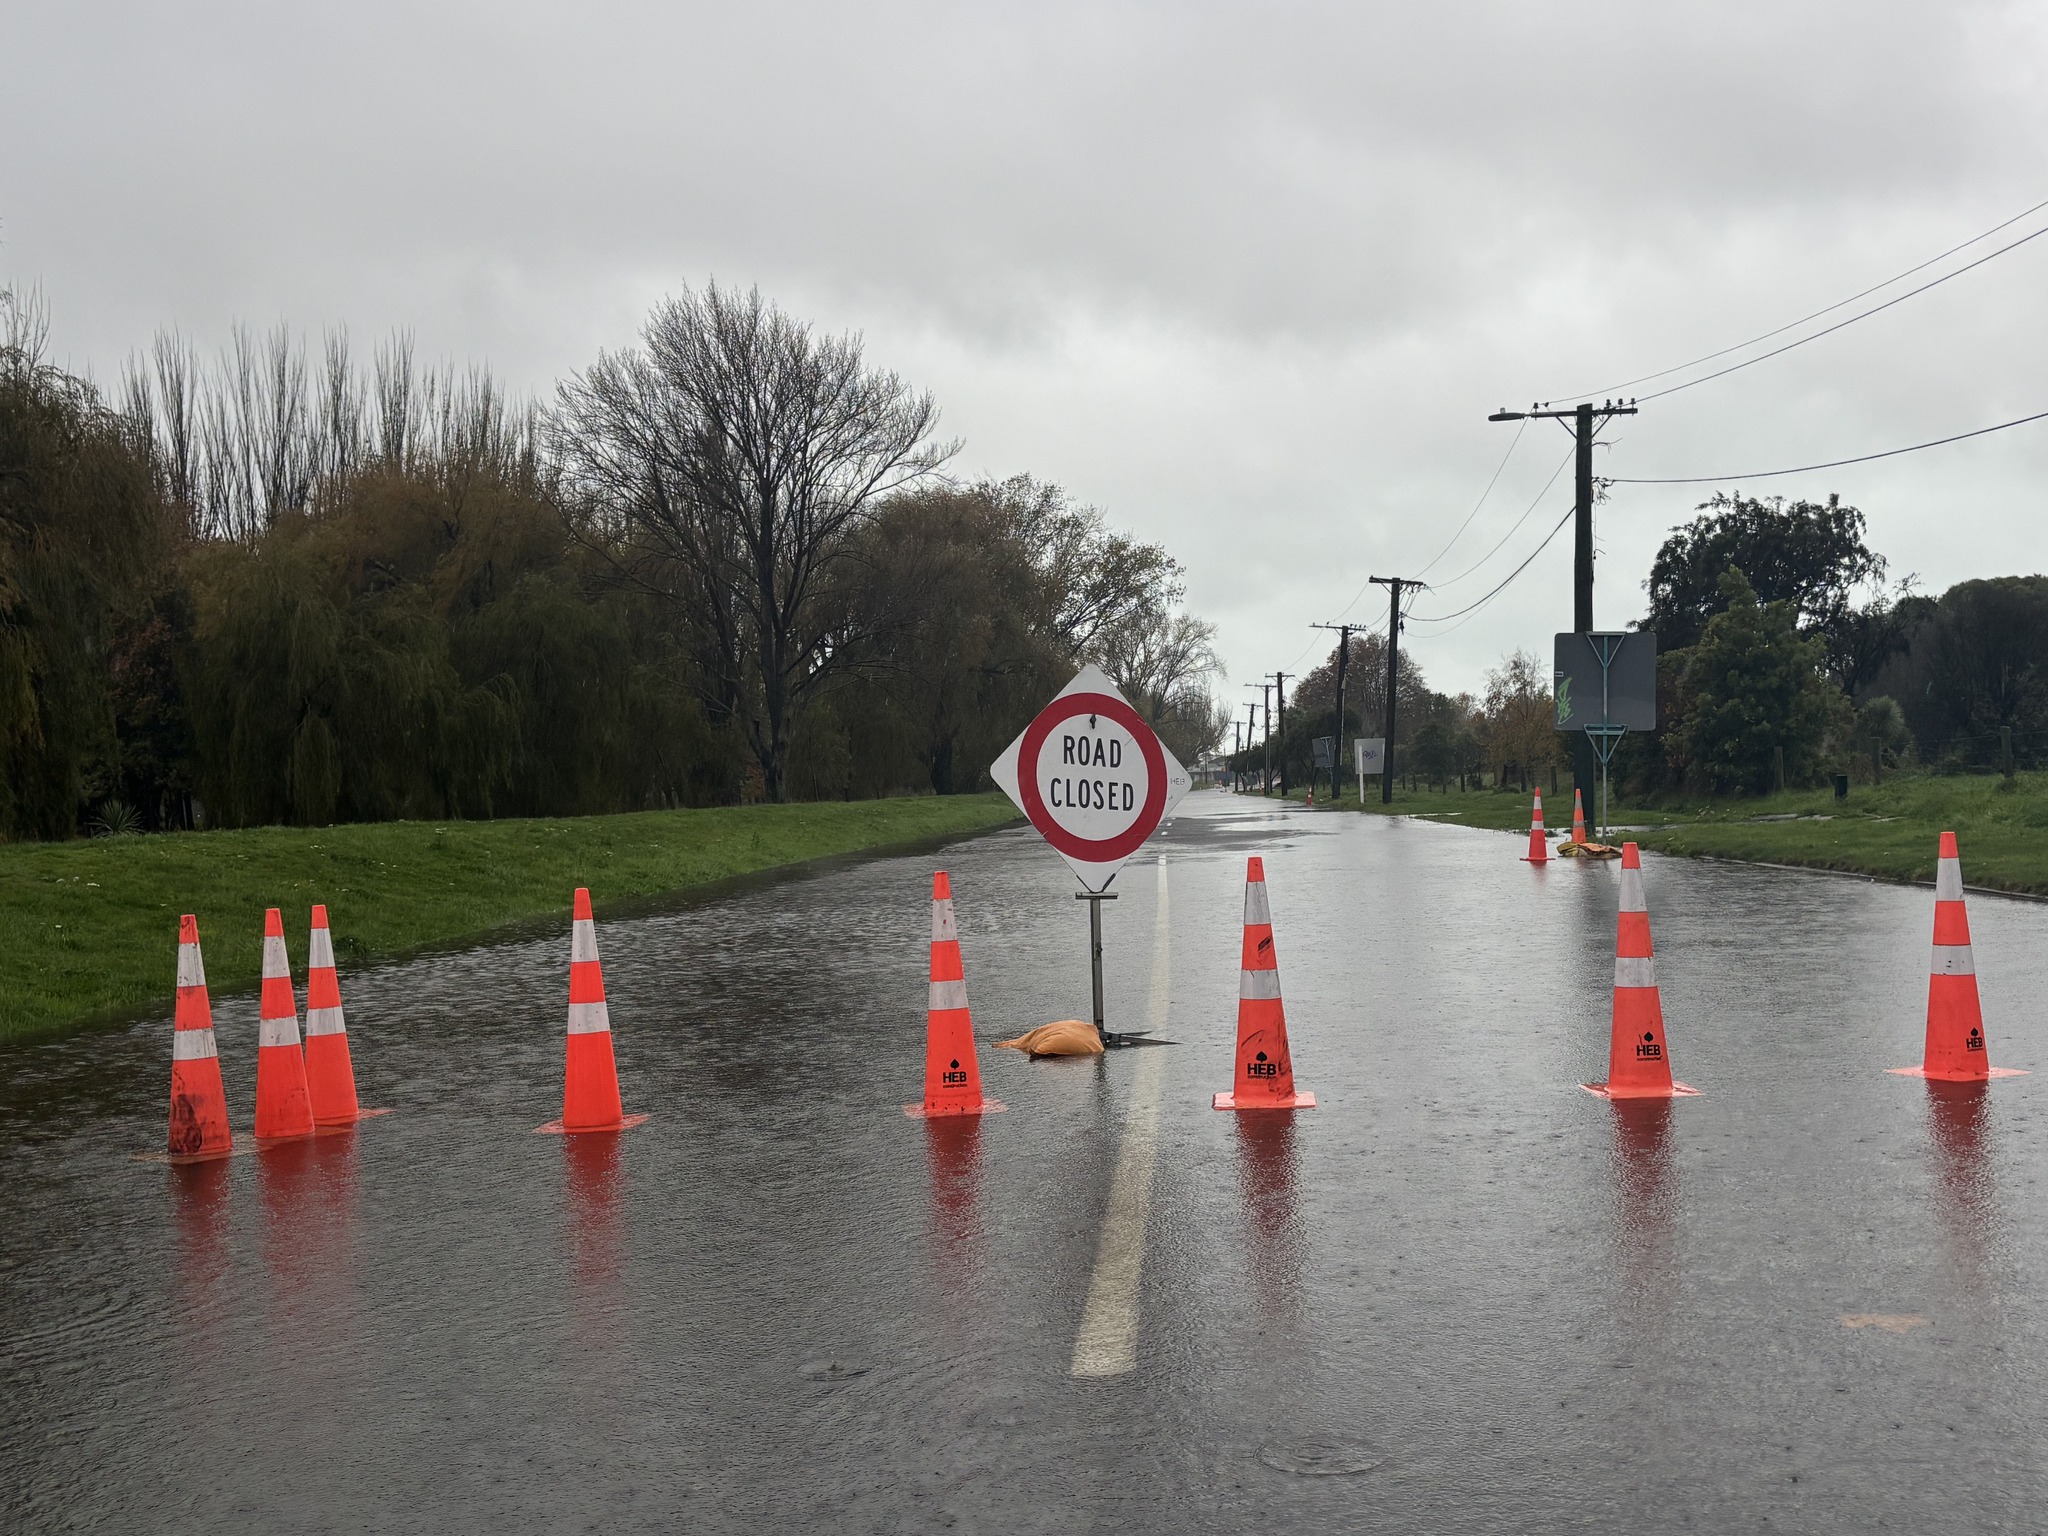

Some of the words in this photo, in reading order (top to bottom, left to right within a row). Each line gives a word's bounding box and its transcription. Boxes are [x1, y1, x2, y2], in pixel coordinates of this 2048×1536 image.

[1063, 735, 1122, 768] ROAD
[1050, 777, 1134, 811] CLOSED
[1966, 1037, 1983, 1049] HEB
[1636, 1044, 1661, 1056] HEB
[1247, 1063, 1277, 1075] HEB
[942, 1071, 967, 1083] HEB
